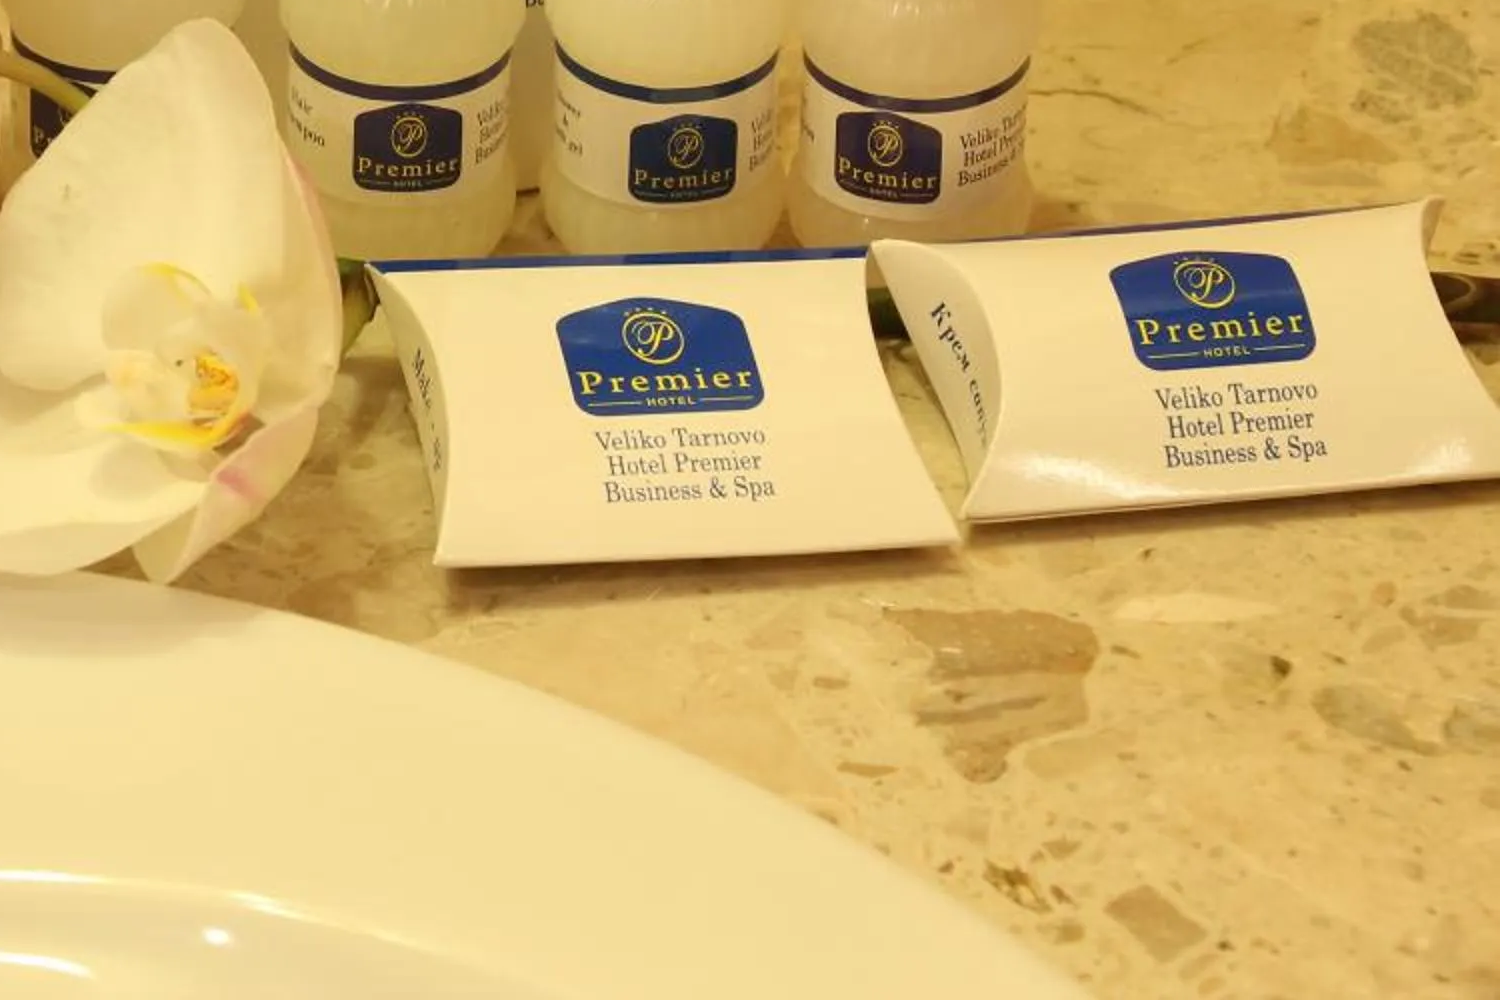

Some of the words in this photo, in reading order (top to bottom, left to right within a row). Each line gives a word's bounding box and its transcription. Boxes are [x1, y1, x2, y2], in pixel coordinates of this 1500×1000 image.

[357, 155, 458, 178] Premier
[634, 167, 733, 189] Premier
[839, 156, 937, 189] Premier
[931, 302, 971, 373] Крем
[1134, 311, 1304, 346] Premier
[1203, 345, 1251, 359] HOTEL
[576, 367, 753, 395] Premier
[646, 396, 697, 407] HOTEL
[1155, 385, 1223, 411] Veliko
[1227, 382, 1318, 406] Tarnovo
[1167, 413, 1224, 439] Hotel
[1229, 407, 1315, 435] Premier
[595, 429, 667, 451] Veliko
[672, 427, 766, 448] Tarnovo
[1163, 442, 1257, 469] Business
[1263, 436, 1281, 461] &
[1287, 434, 1328, 463] Spa
[607, 453, 667, 477] Hotel
[673, 450, 763, 473] Premier
[604, 480, 703, 504] Business
[709, 476, 727, 499] &
[733, 475, 776, 502] Spa
